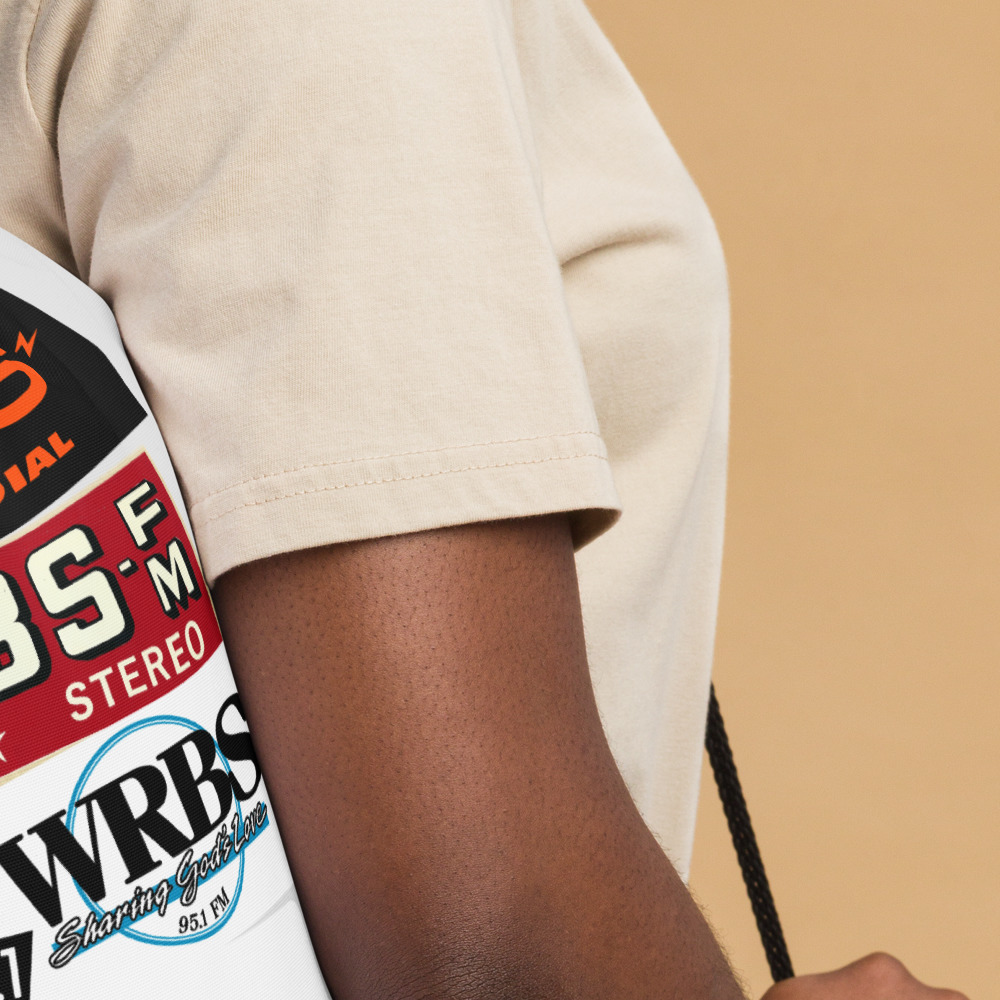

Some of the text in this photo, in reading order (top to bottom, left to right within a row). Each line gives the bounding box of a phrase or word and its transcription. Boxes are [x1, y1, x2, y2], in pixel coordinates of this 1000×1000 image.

[65, 621, 205, 722] STEREO
[49, 801, 267, 969] Sharing God's Love
[179, 886, 231, 934] 95.1 FM
